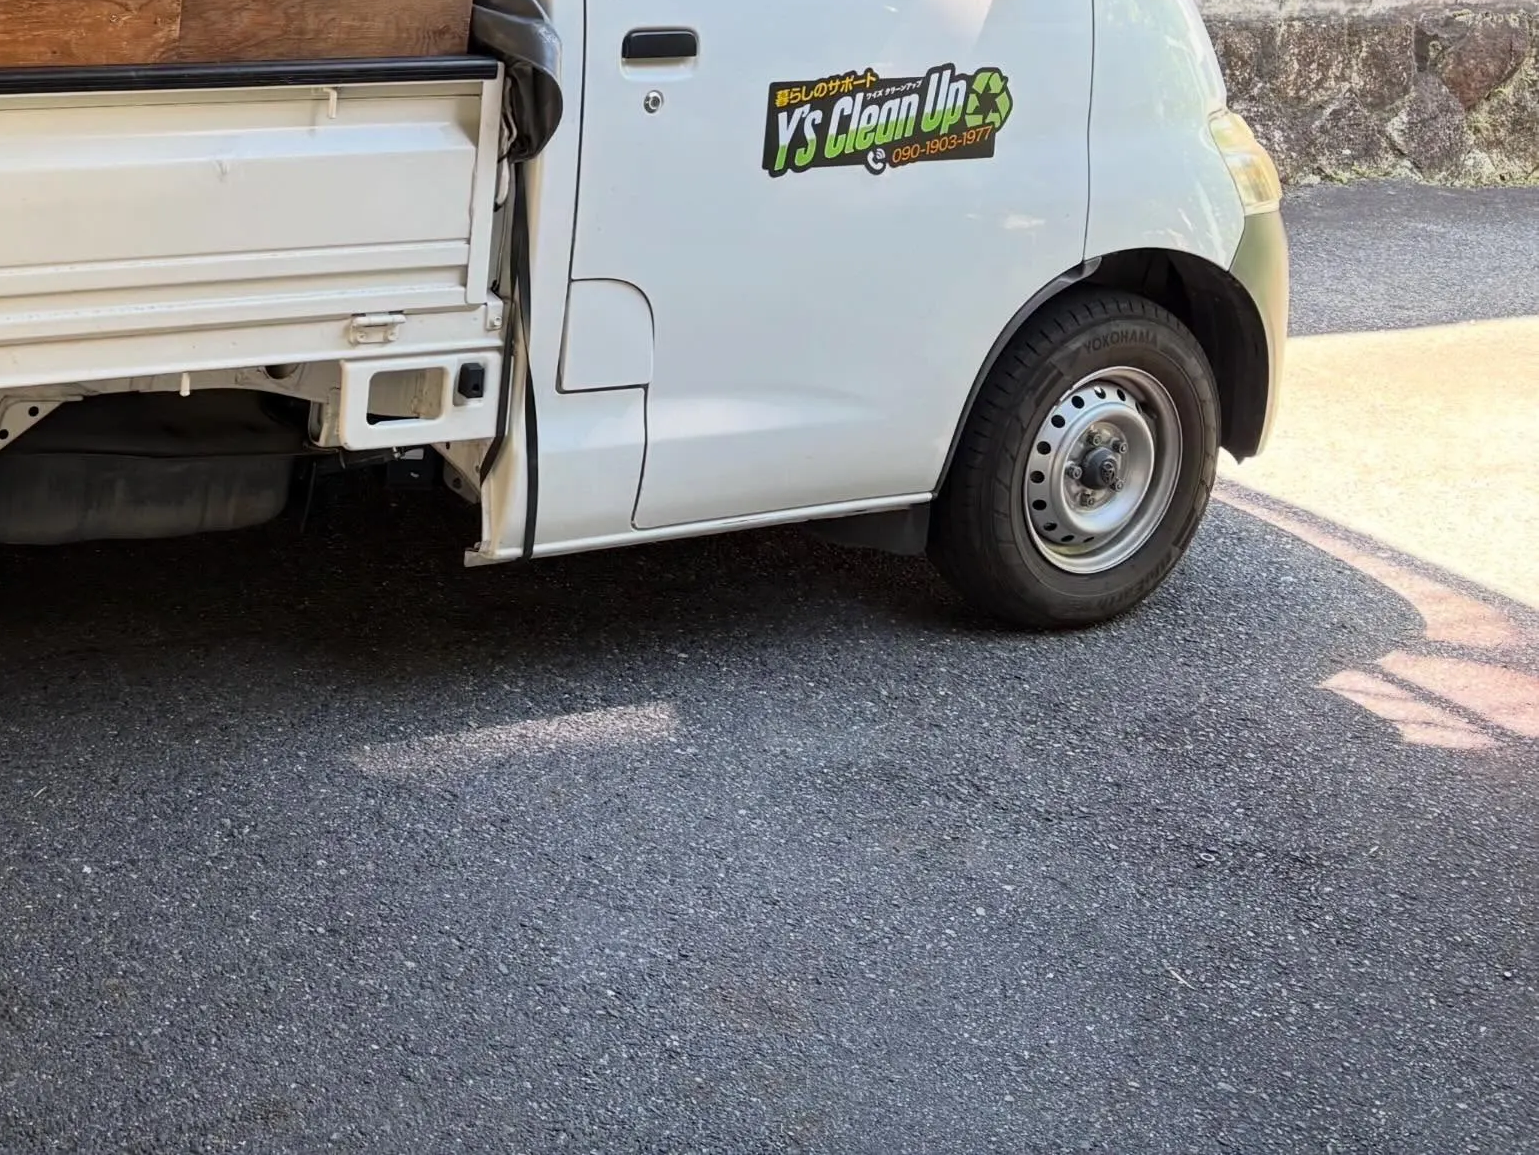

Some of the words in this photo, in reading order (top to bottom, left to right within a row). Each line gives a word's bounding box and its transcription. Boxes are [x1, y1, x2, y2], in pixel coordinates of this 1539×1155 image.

[776, 72, 877, 107] 暮らしのサポート
[824, 92, 919, 159] Clean
[920, 69, 967, 134] Up
[892, 126, 992, 163] 090-1903-1977
[1083, 329, 1158, 353] YOKOHAMA
